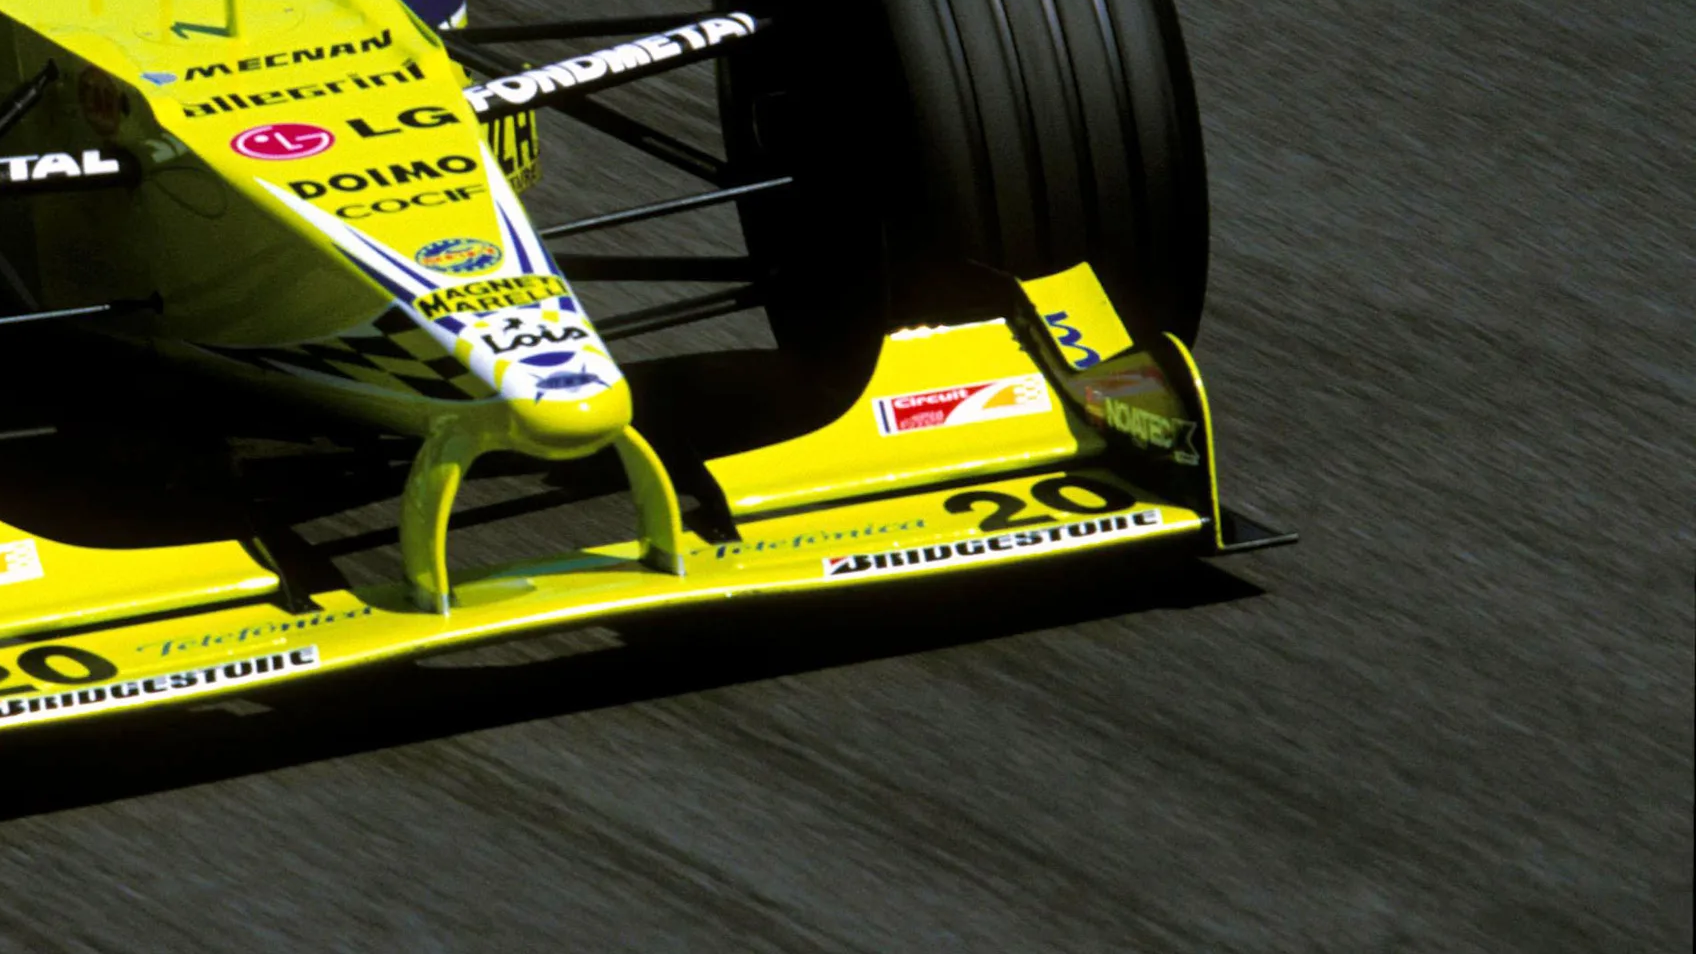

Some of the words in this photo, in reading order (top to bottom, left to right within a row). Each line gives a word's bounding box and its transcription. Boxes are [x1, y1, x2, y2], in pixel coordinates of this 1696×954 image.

[346, 105, 461, 139] LG
[288, 154, 477, 201] DOIMO
[335, 184, 486, 219] COCIF
[481, 323, 588, 355] Lois
[893, 389, 968, 409] Circuit
[943, 472, 1136, 533] 20
